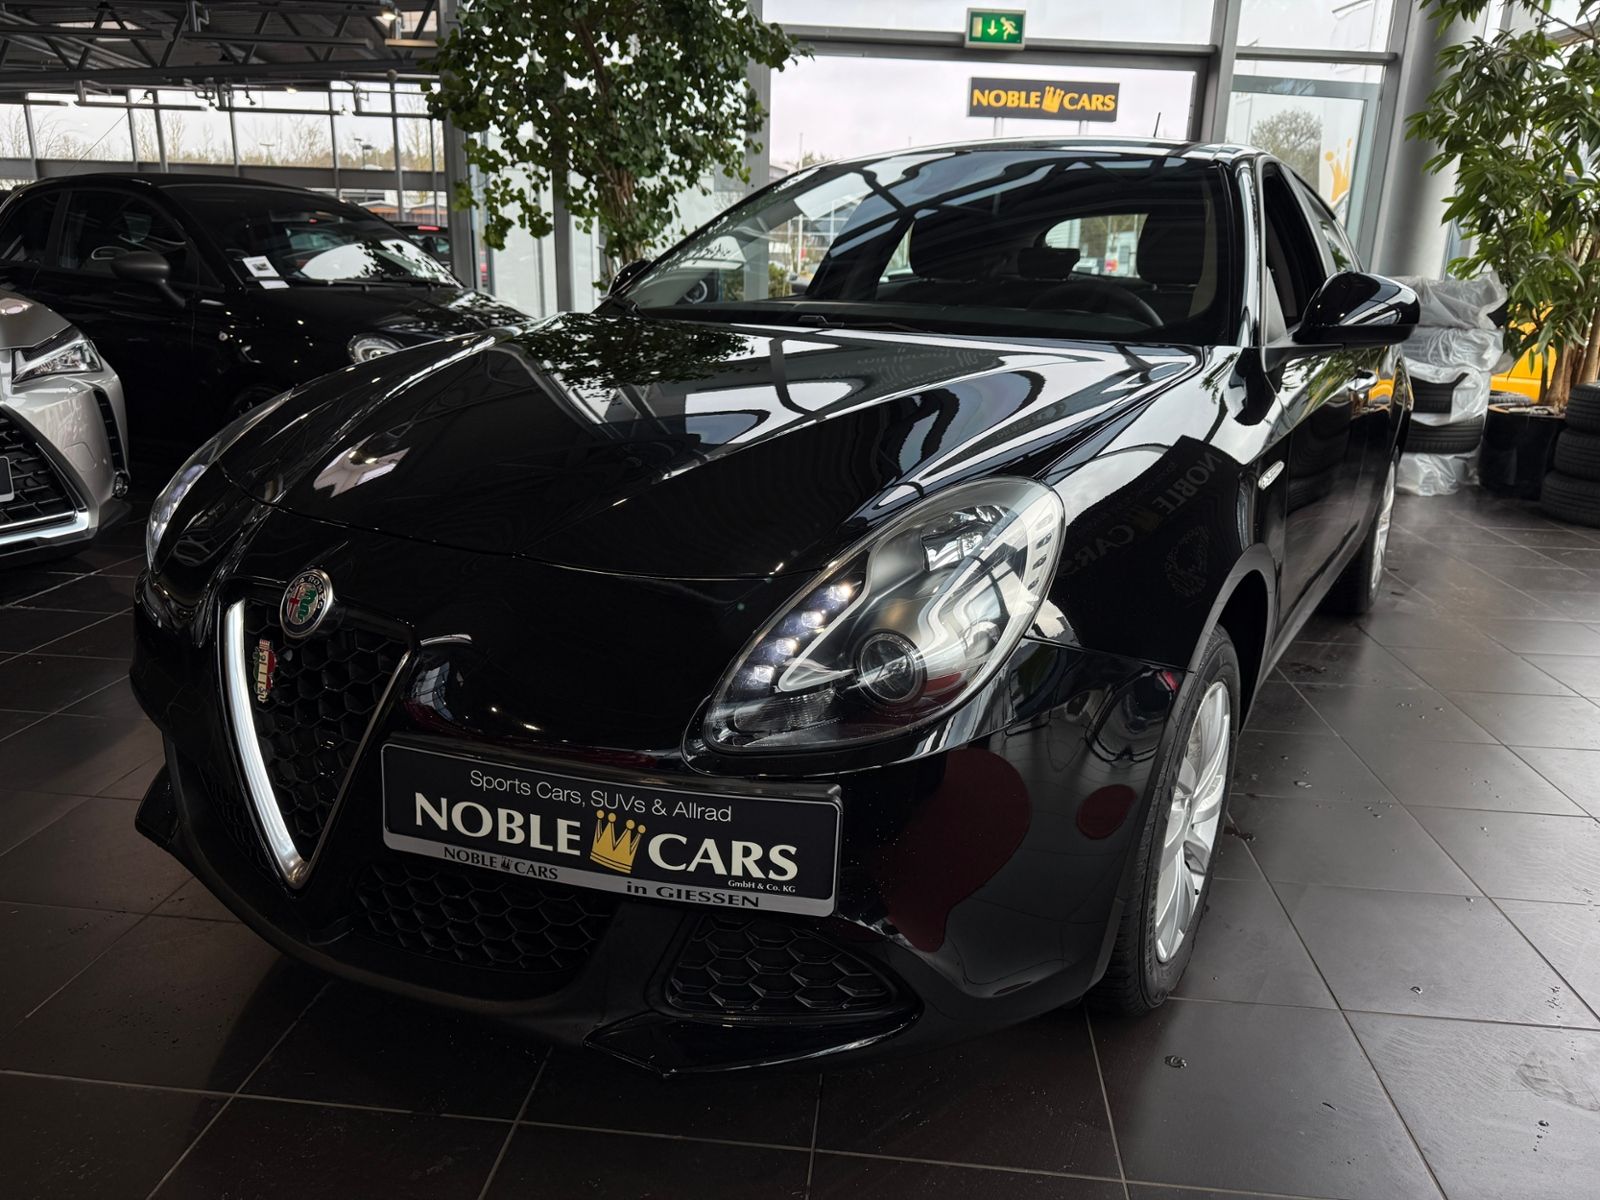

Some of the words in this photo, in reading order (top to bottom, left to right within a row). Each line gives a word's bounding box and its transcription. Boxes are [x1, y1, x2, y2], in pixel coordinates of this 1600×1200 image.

[972, 89, 1041, 108] NOBLE
[1063, 92, 1116, 111] CARS
[470, 770, 531, 795] Sports
[536, 781, 586, 807] Cars,
[590, 790, 646, 813] SUVs
[652, 799, 667, 815] &
[673, 801, 732, 822] Allrad
[415, 791, 581, 856] NOBLE
[648, 833, 798, 881] CARS
[444, 846, 497, 868] NOBLE
[514, 861, 558, 880] CARS
[626, 881, 647, 895] in
[656, 886, 760, 908] GIESSEN
[728, 879, 755, 889] GmbH
[757, 882, 764, 890] &
[766, 883, 780, 891] Co.
[783, 884, 796, 893] KG
